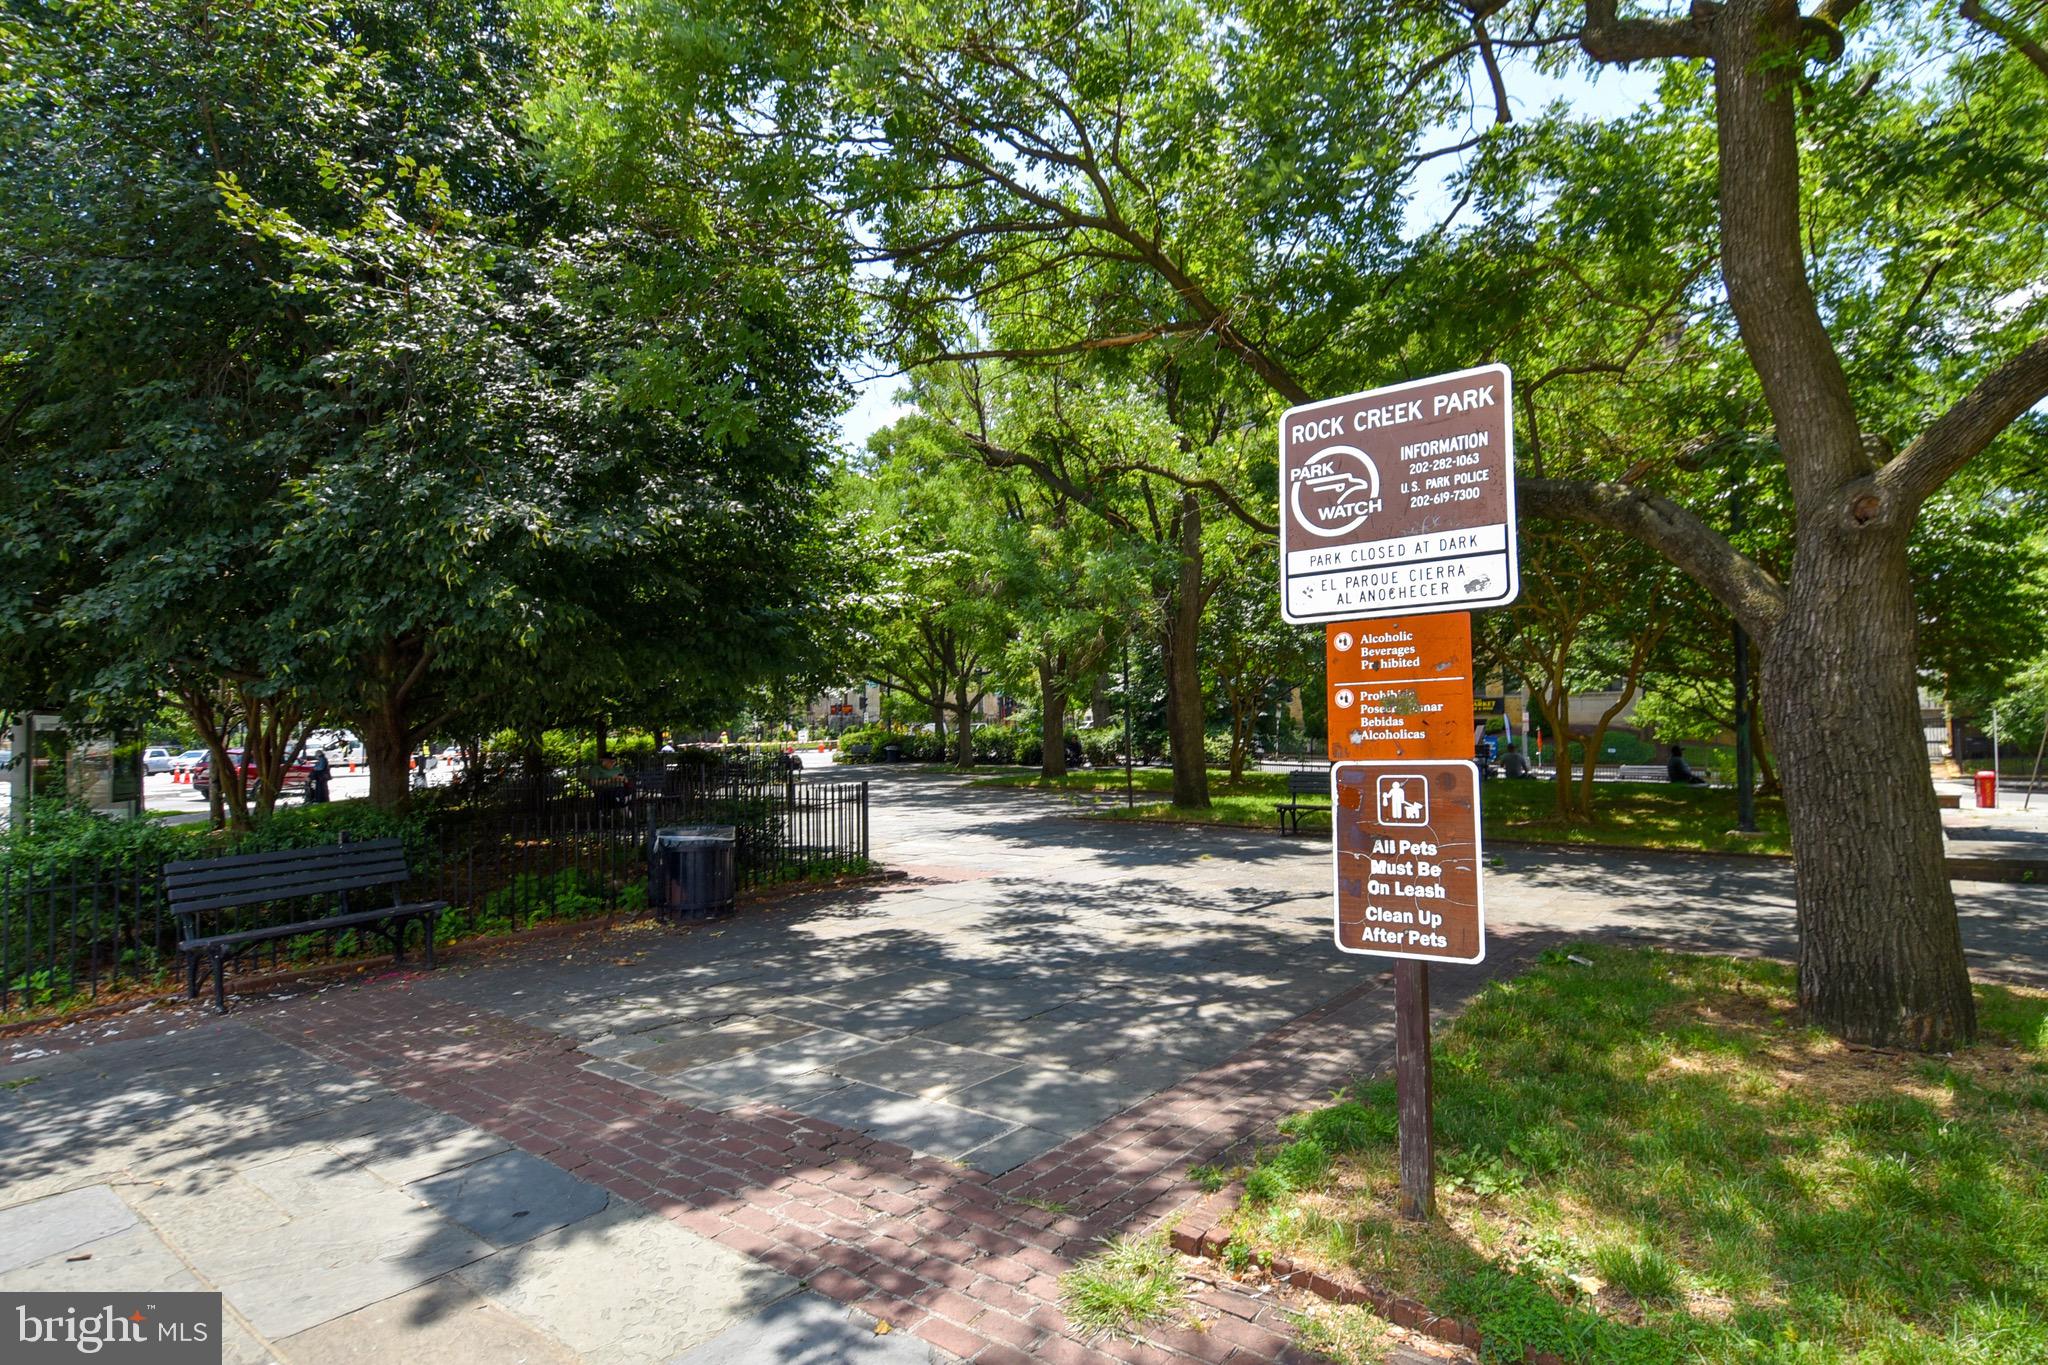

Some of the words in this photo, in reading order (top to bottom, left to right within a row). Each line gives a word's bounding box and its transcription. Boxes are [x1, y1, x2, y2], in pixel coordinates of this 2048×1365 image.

[1292, 415, 1344, 444] ROCK
[1353, 399, 1423, 432] CREEK
[1434, 385, 1495, 417] PARK
[1400, 431, 1489, 460] INFORMATION
[1290, 461, 1335, 482] PARK
[1409, 453, 1480, 475] 202-282-1063
[1401, 479, 1421, 494] U.S.
[1425, 473, 1450, 490] PARK
[1454, 468, 1490, 487] POLICE
[1410, 487, 1480, 508] 202-619-7300
[1318, 498, 1382, 521] WATCH
[1310, 548, 1342, 567] PARK
[1350, 539, 1406, 562] CLOSED
[1415, 540, 1430, 554] AT
[1440, 534, 1478, 551] DARK
[1321, 579, 1337, 592] EL
[1345, 571, 1399, 589] PARQUE
[1409, 564, 1466, 582] CIERRA
[1336, 592, 1352, 605] AL
[1359, 582, 1449, 603] ANOCHECER
[1360, 631, 1413, 644] Alcoholic
[1361, 644, 1416, 658] Beverages
[1361, 656, 1420, 670] Prhibited
[1361, 717, 1404, 728] Bebidas
[1360, 729, 1426, 741] Alcoholicas
[1372, 839, 1396, 855] All
[1399, 840, 1438, 856] Pets
[1370, 860, 1414, 877] Must
[1418, 861, 1442, 877] Be
[1367, 880, 1390, 896] On
[1394, 882, 1446, 899] Leash
[1365, 906, 1414, 924] Clean
[1418, 910, 1442, 928] Up
[1361, 926, 1404, 944] After
[1408, 930, 1448, 948] Pets
